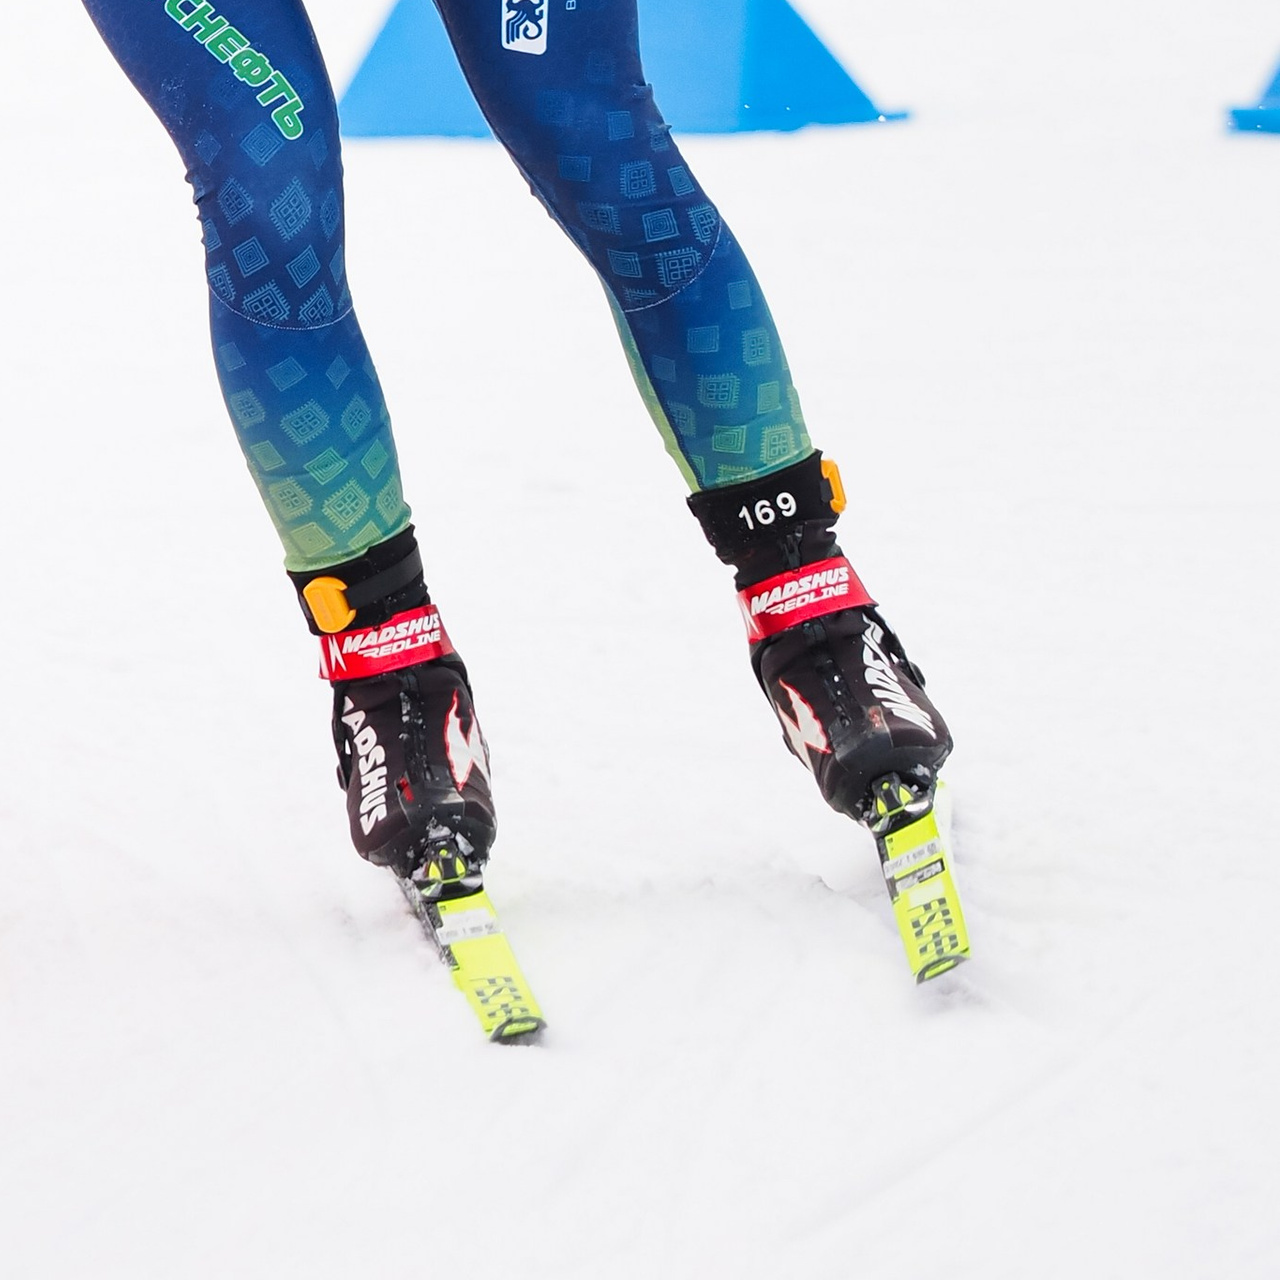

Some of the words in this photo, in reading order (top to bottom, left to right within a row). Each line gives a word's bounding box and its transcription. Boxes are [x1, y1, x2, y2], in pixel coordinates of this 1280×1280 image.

[738, 491, 797, 530] 169
[750, 566, 849, 616] MADSHUS
[765, 583, 849, 616] REDLINE
[342, 613, 440, 654] MADSHUS
[357, 630, 441, 658] REDLINE
